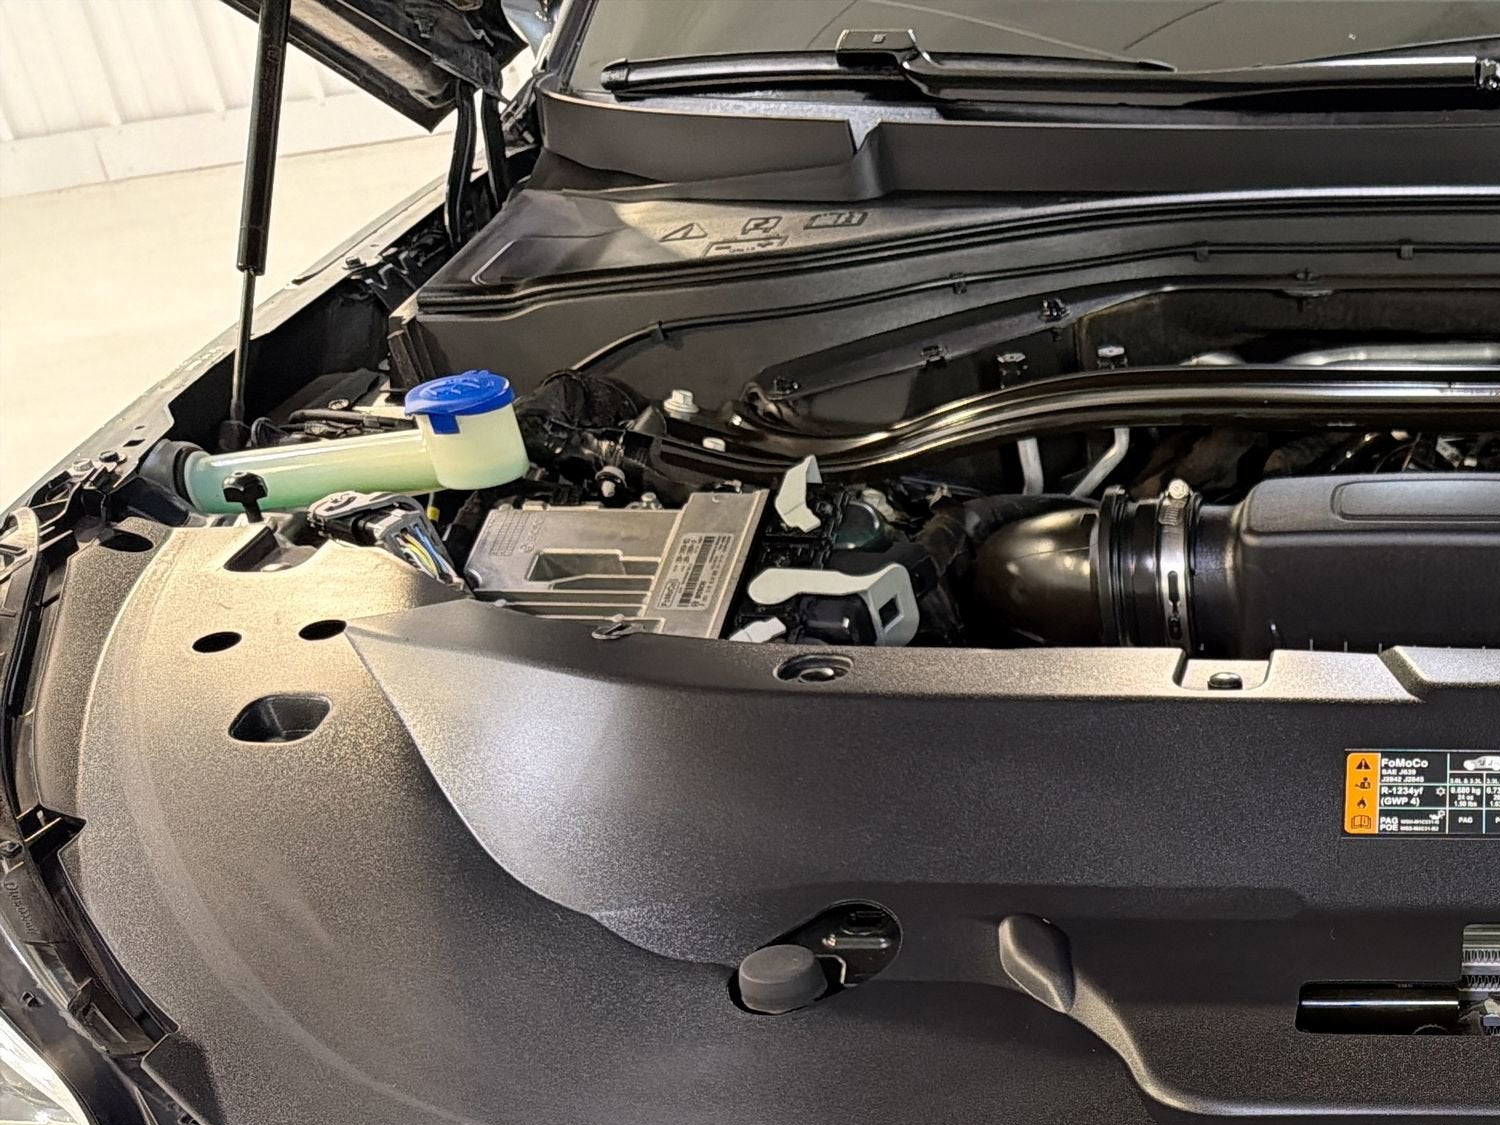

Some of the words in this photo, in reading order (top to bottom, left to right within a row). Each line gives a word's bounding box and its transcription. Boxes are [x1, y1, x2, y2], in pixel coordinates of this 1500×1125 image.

[1381, 758, 1428, 768] FoMoCo
[1381, 786, 1424, 796] R-1234yf
[1471, 787, 1481, 796] kg
[1381, 797, 1410, 806] (GWP
[1410, 797, 1420, 806] 4)
[1380, 816, 1398, 824] PAG
